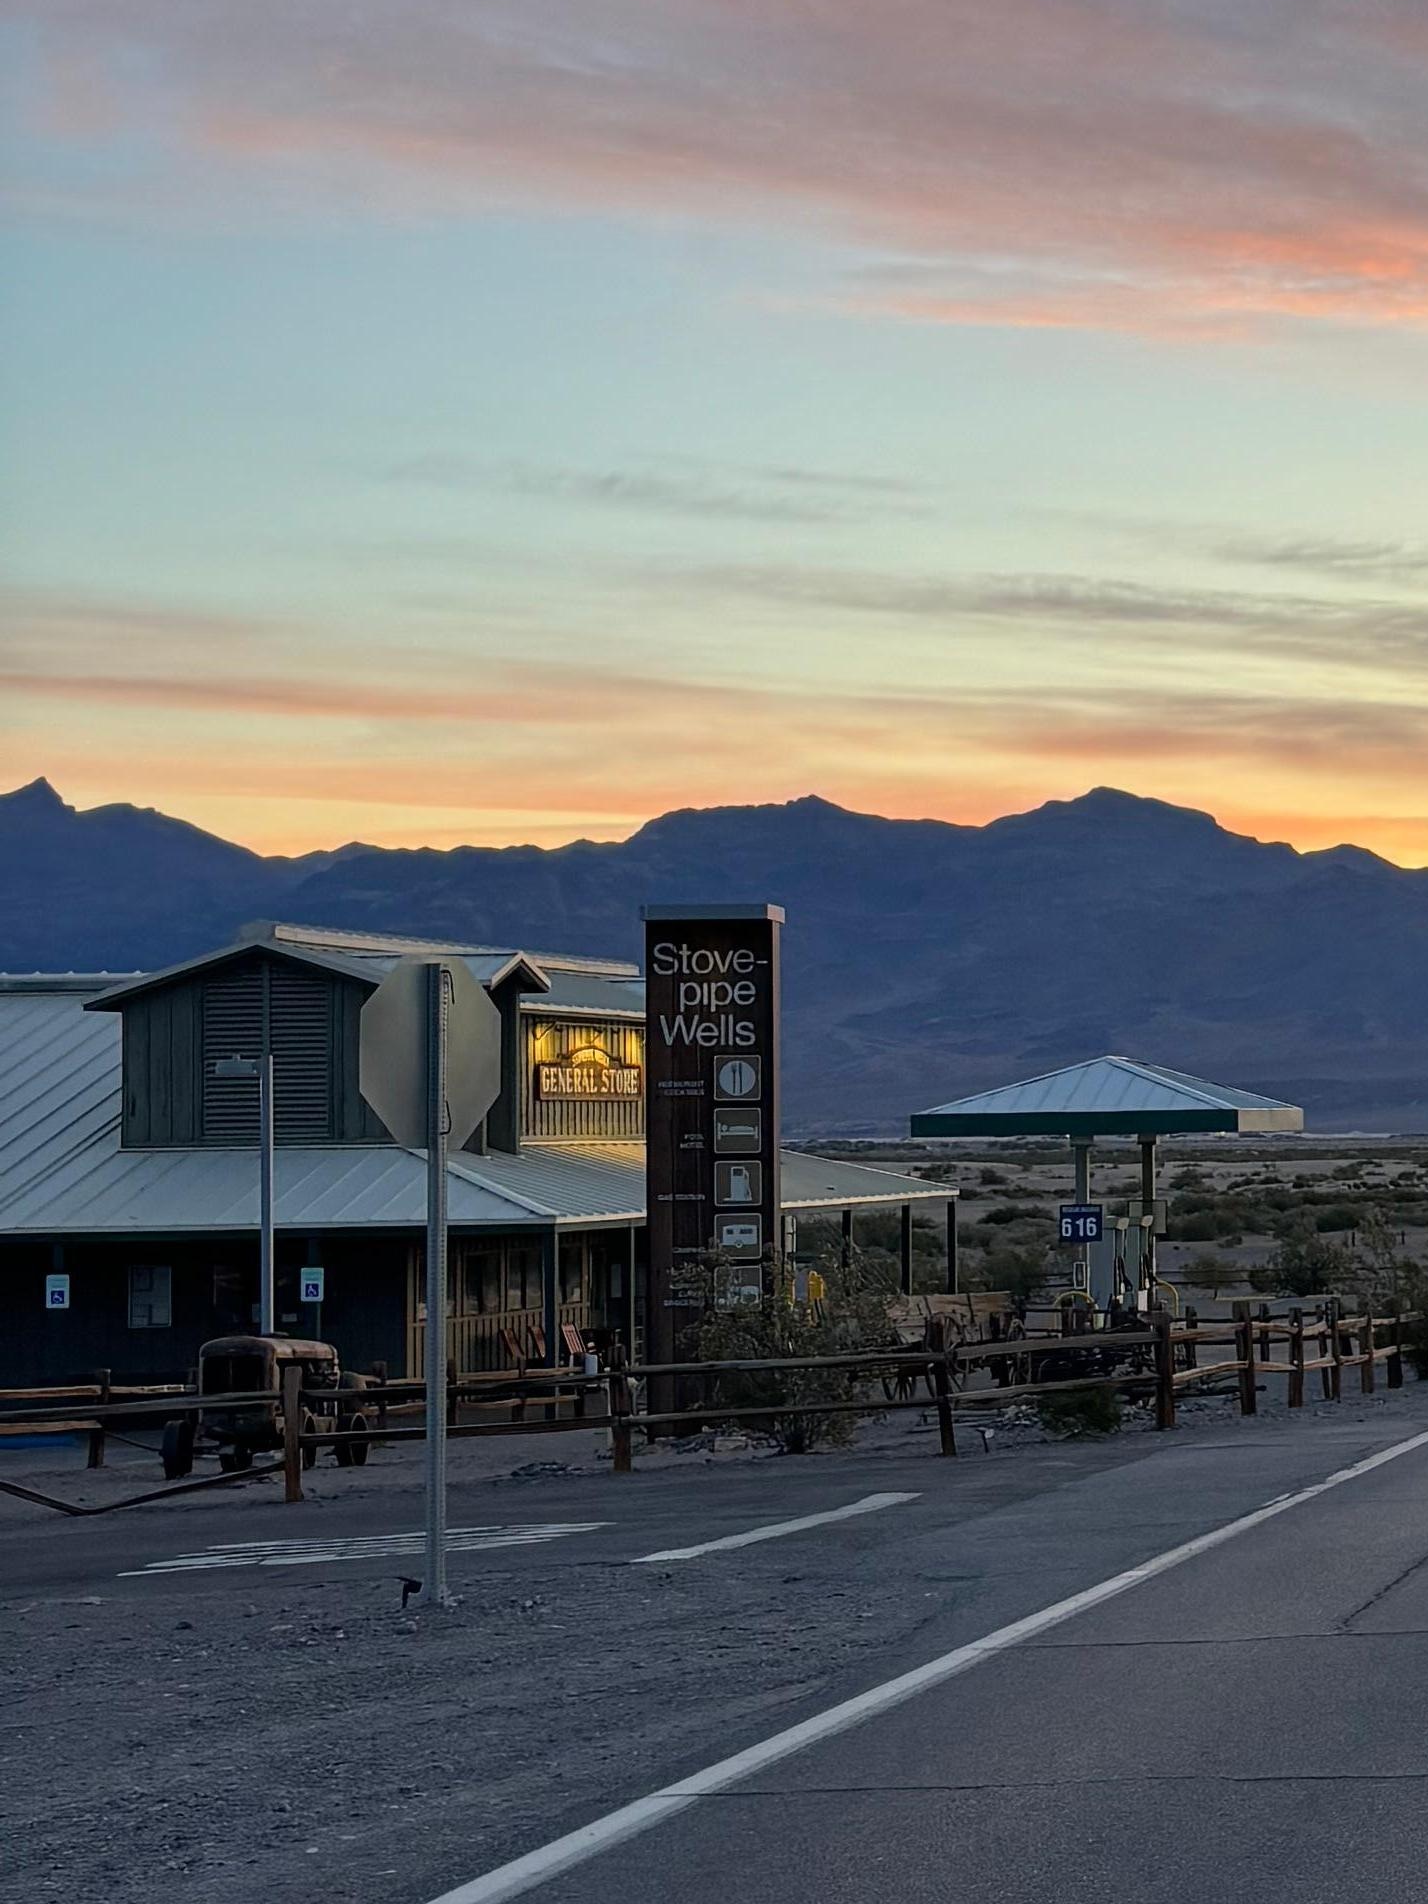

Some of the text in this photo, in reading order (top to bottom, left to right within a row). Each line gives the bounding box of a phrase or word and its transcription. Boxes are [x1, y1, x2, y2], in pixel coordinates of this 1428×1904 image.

[653, 943, 768, 975] Stove-
[680, 981, 756, 1012] pipe
[660, 1014, 756, 1046] Wells
[542, 1067, 640, 1094] GENERAL STORE
